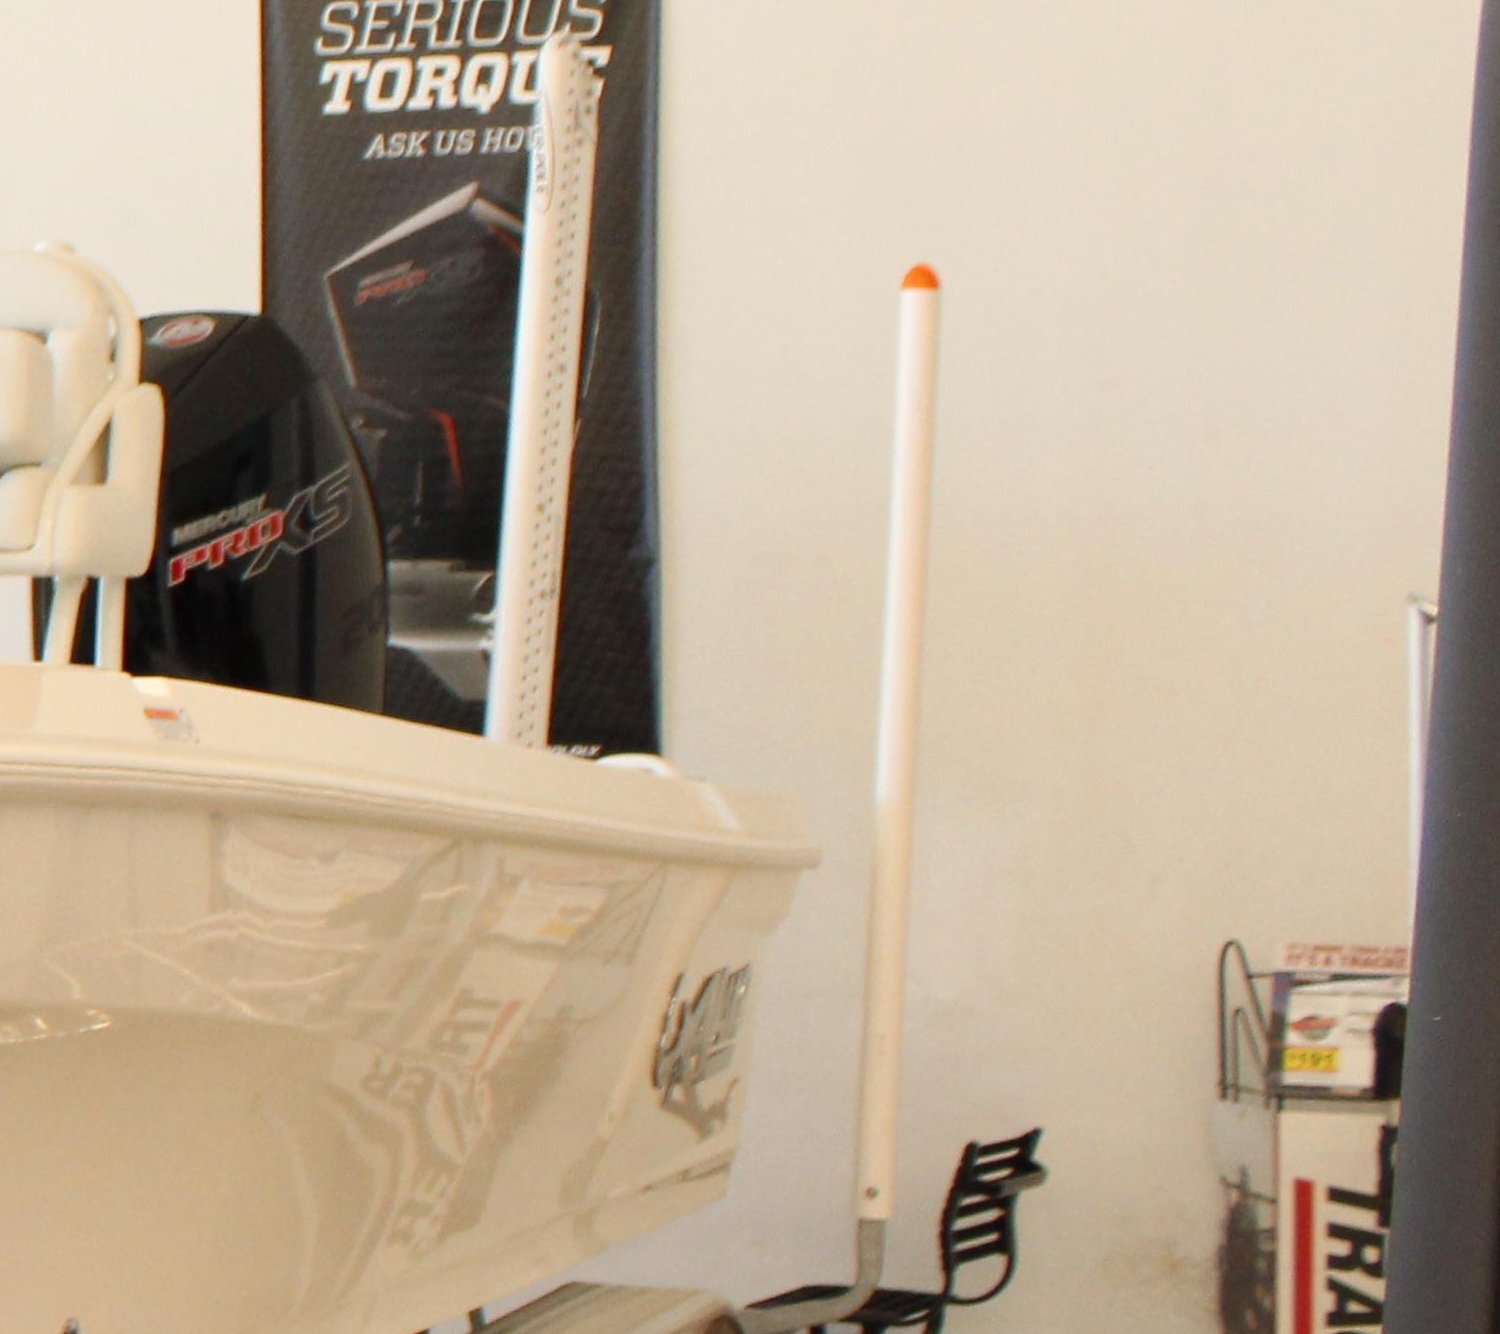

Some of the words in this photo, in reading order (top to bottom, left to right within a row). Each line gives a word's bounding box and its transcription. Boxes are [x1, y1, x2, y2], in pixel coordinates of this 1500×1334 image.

[364, 130, 433, 160] ASK
[433, 128, 478, 155] US
[168, 510, 286, 587] PRO
